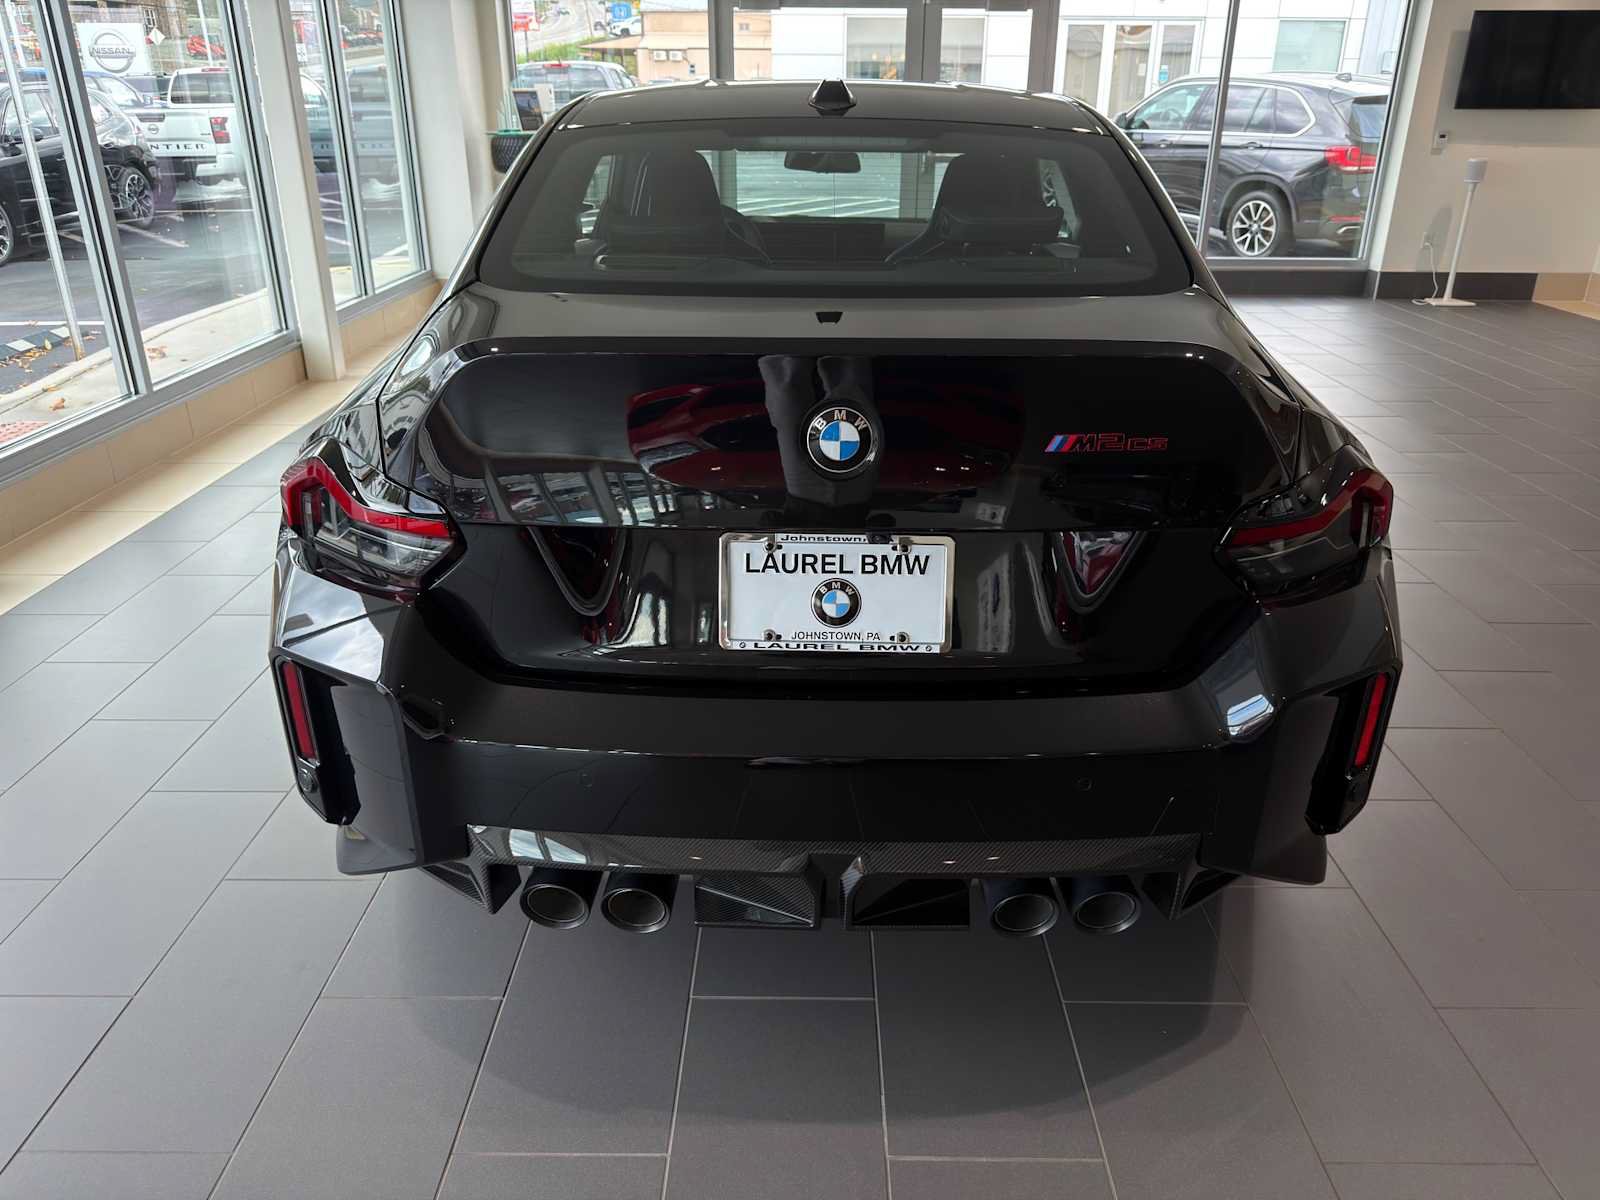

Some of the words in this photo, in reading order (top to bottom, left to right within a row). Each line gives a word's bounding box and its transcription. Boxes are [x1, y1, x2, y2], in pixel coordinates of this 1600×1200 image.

[91, 47, 130, 55] NISSAN
[814, 409, 867, 430] BMW
[745, 553, 853, 574] LAUREL
[860, 554, 930, 575] BMW
[819, 581, 855, 595] BMW
[866, 632, 881, 641] PA
[753, 642, 849, 651] LAUREL
